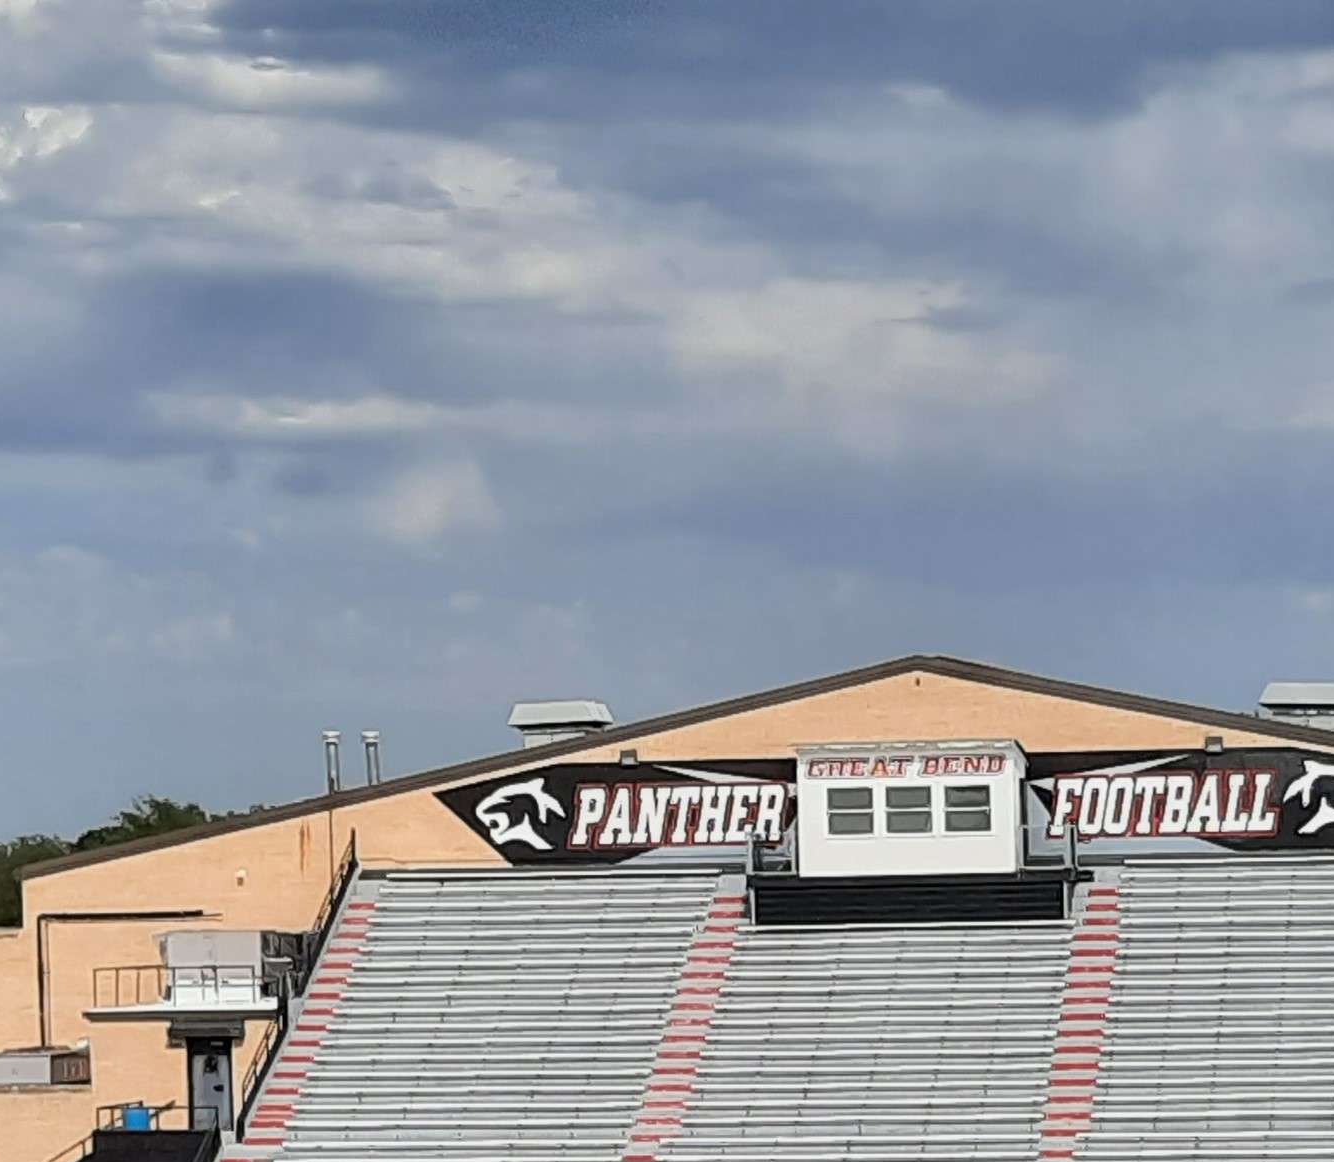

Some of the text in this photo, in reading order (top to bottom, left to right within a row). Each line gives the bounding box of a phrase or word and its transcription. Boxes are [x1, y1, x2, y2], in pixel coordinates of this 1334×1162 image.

[806, 753, 1007, 778] GREAT BEND
[568, 782, 790, 849] PANTHER
[1047, 769, 1280, 838] FOOTBALL
